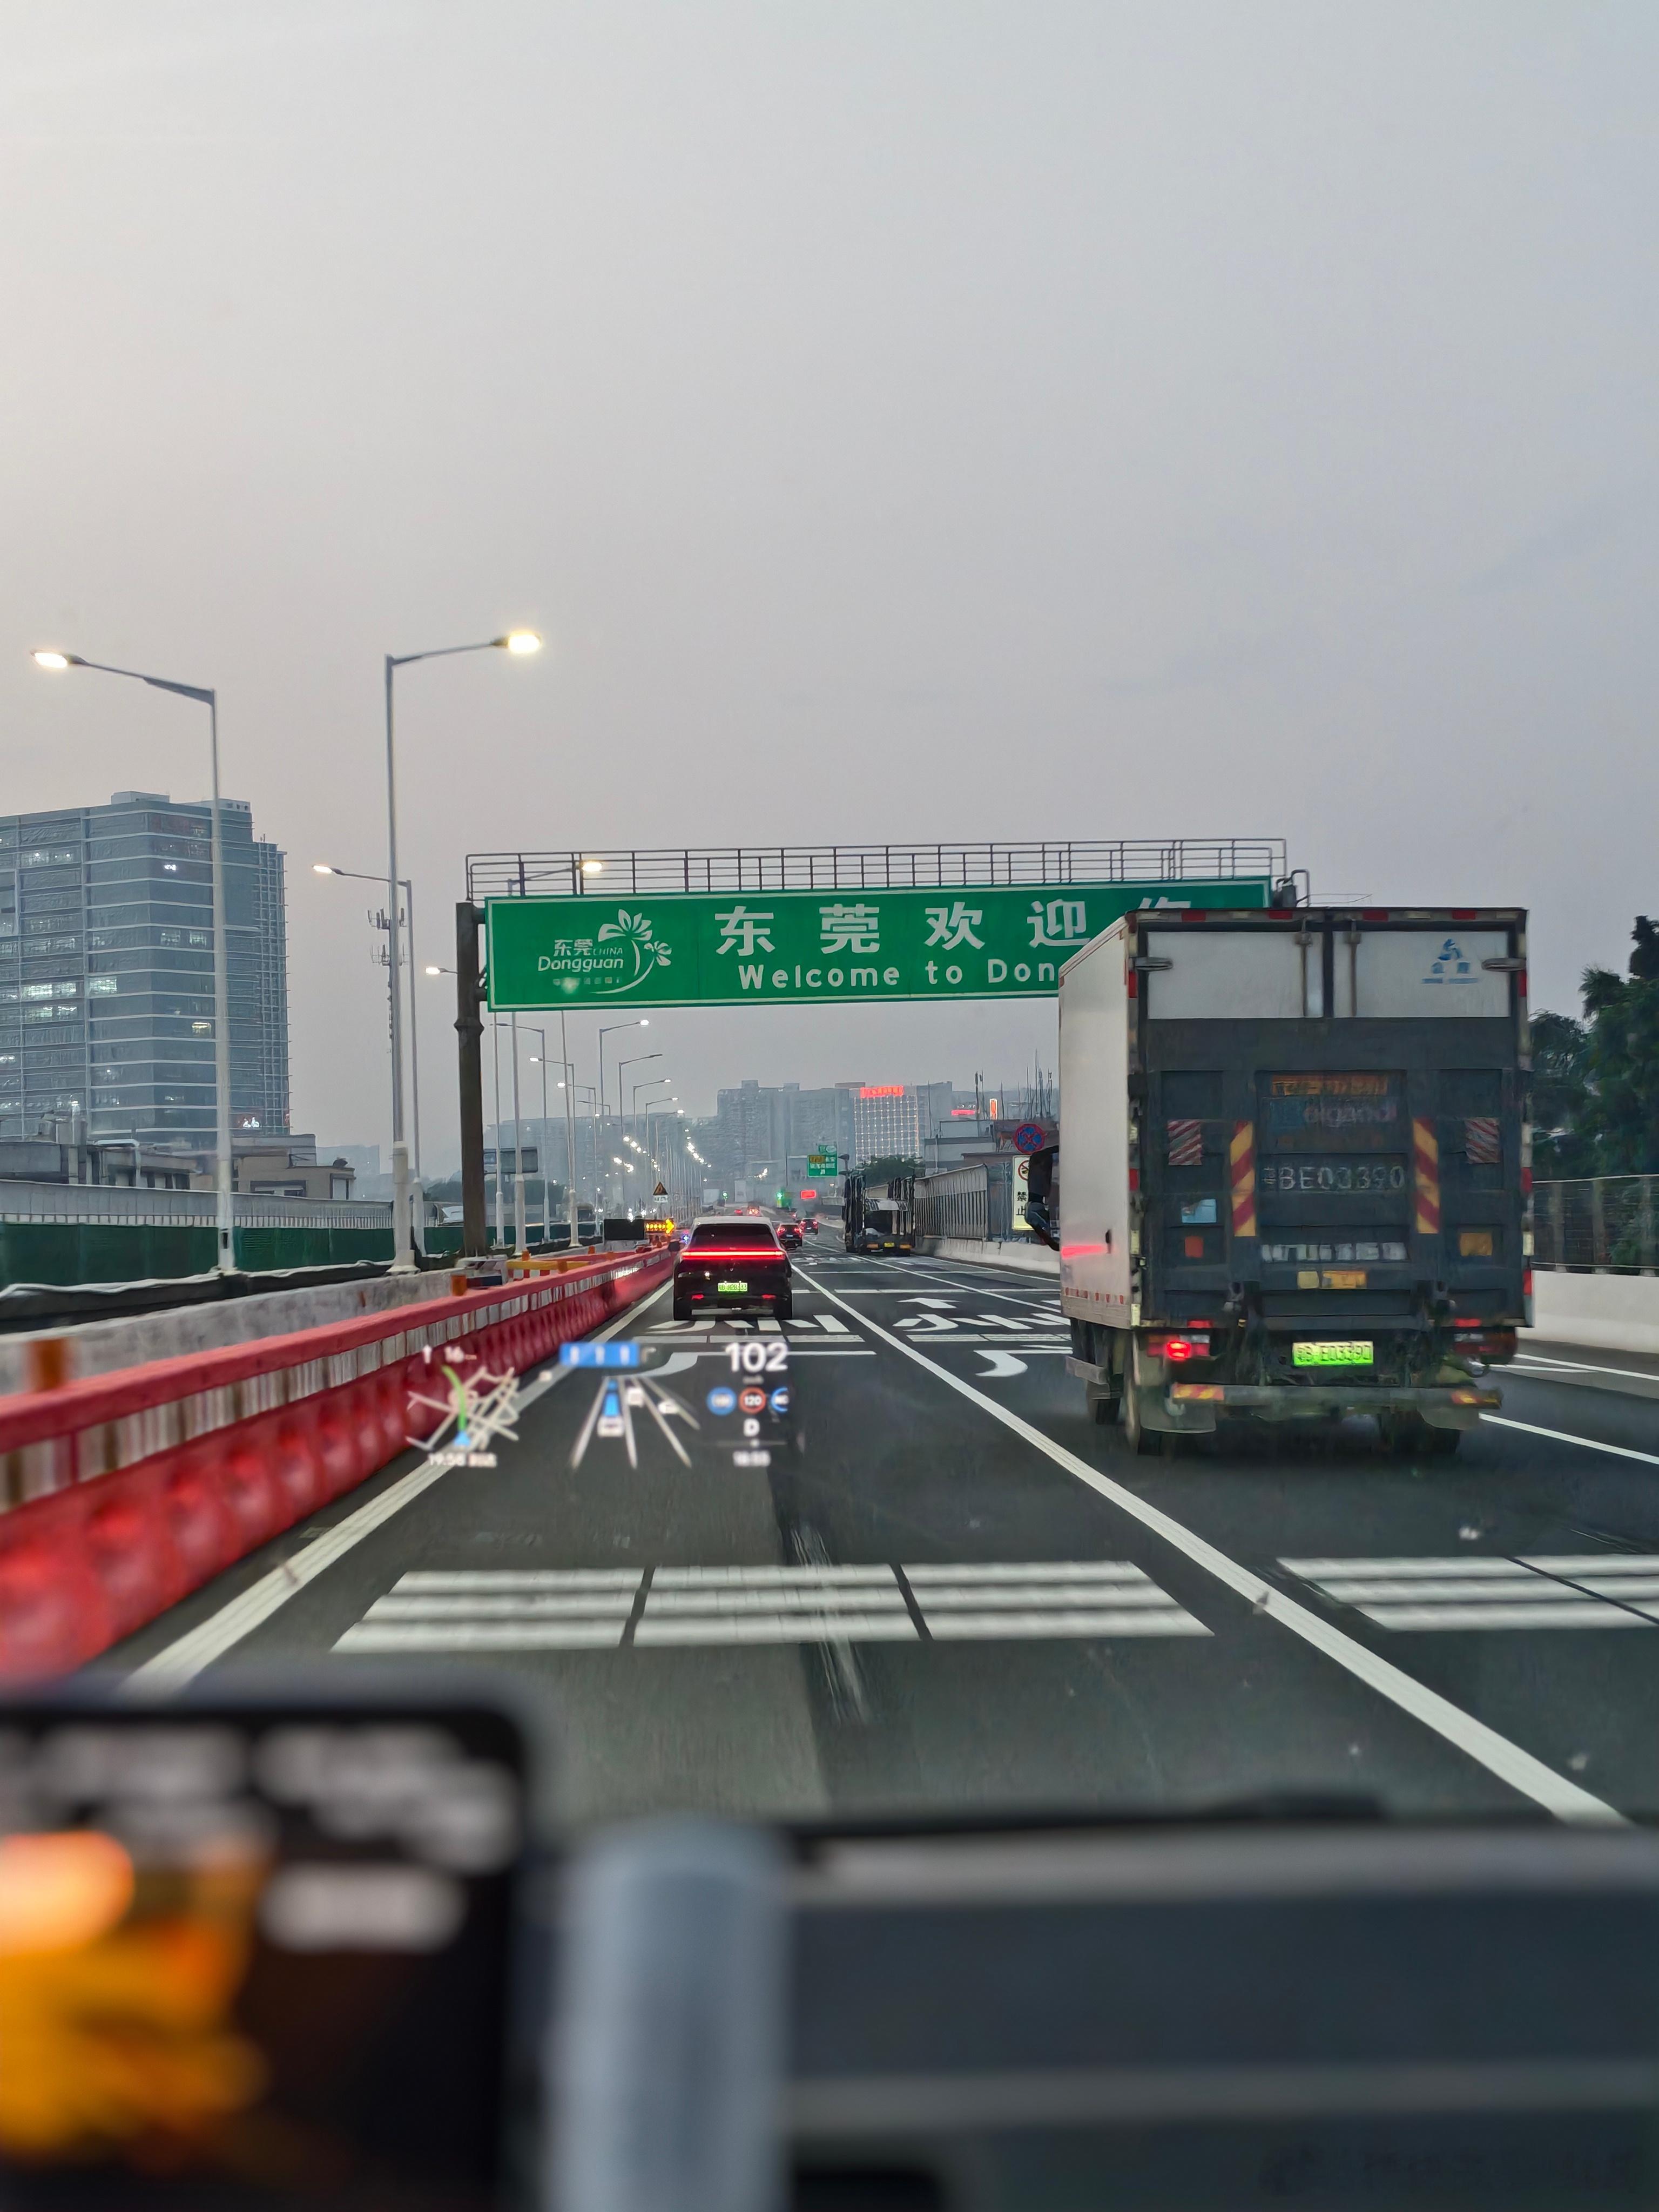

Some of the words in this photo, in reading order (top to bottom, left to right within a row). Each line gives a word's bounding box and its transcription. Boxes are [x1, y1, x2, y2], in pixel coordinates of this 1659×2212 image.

[715, 896, 1191, 956] 东莞欢迎
[553, 939, 593, 956] 东莞
[538, 956, 624, 973] Dongguan
[738, 964, 900, 989] Welcome
[925, 960, 963, 984] to
[725, 1342, 788, 1373] 102
[744, 1395, 763, 1406] 120
[743, 1418, 760, 1437] D
